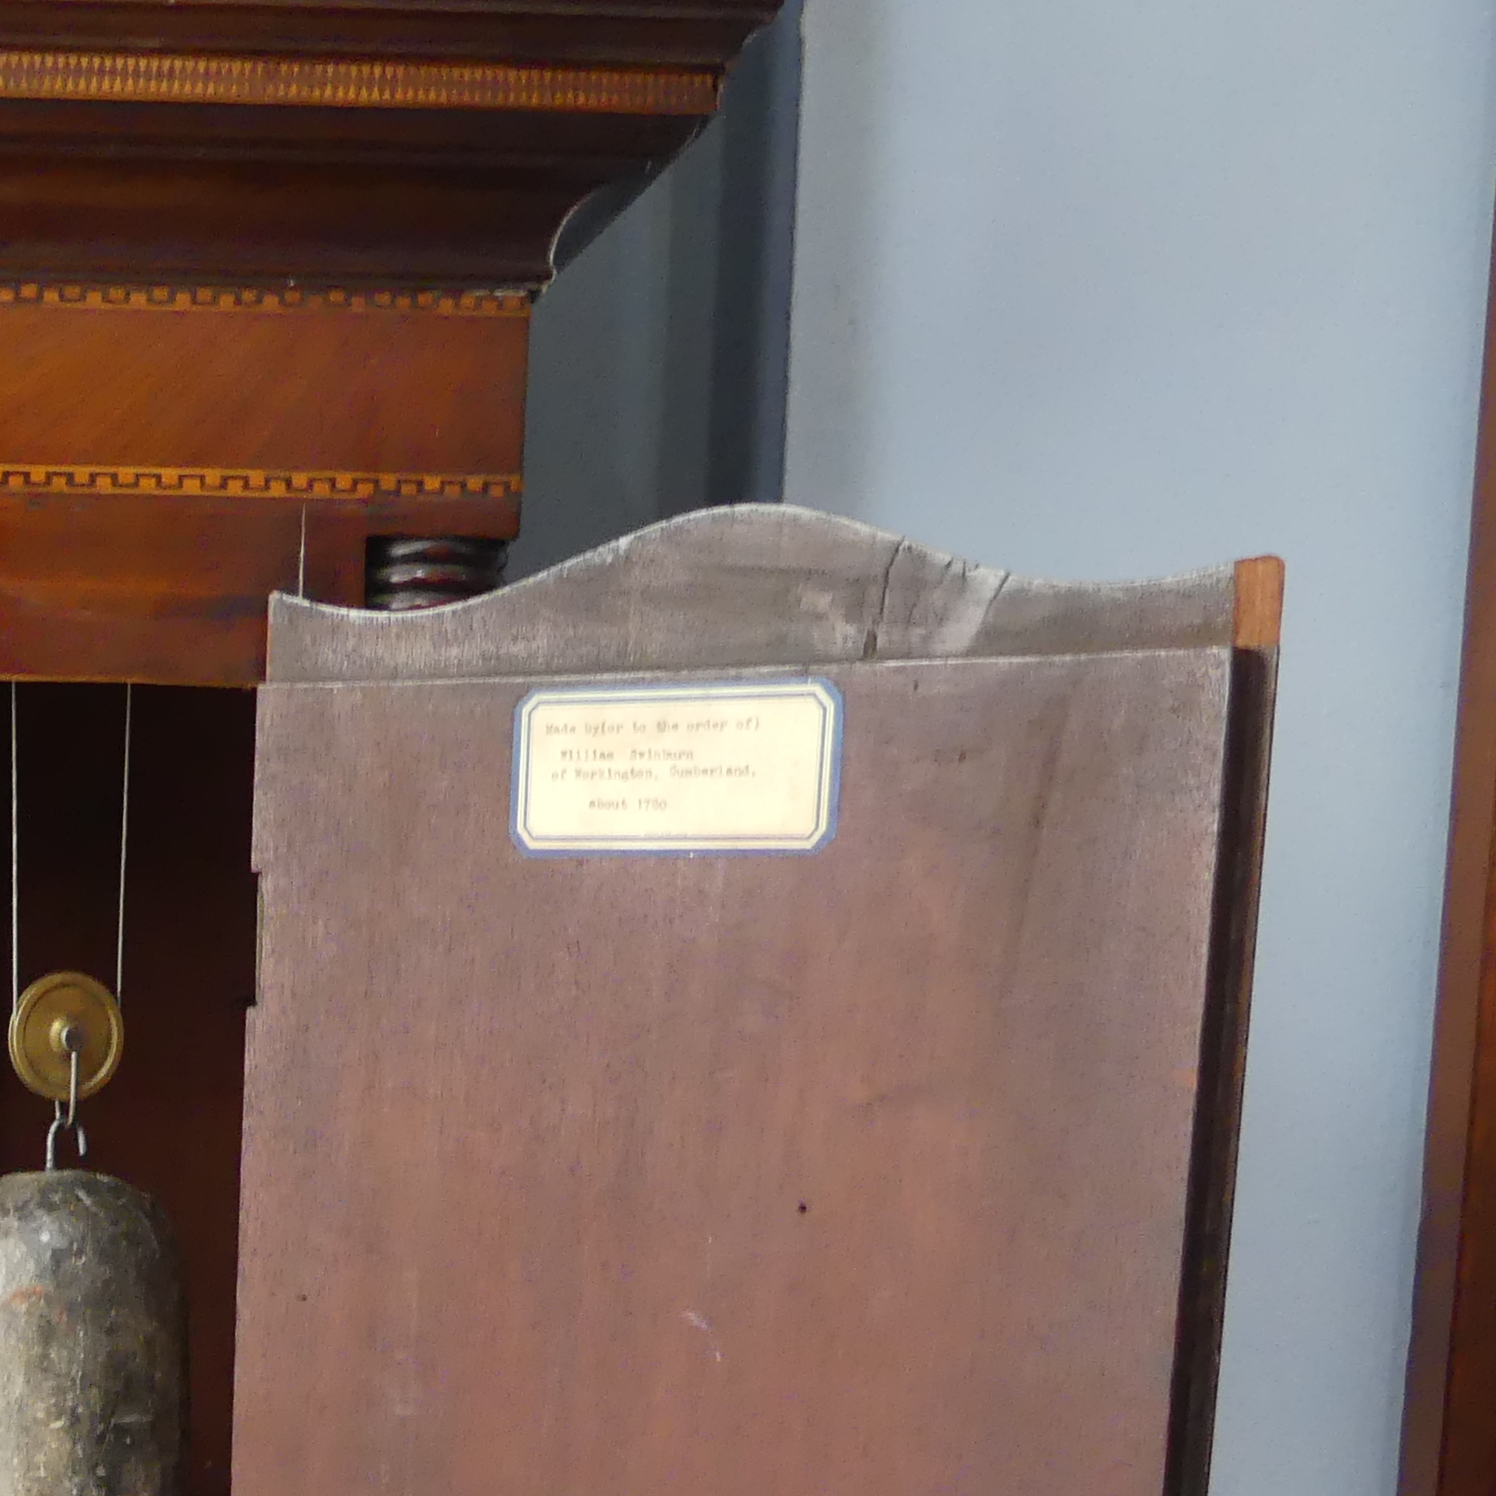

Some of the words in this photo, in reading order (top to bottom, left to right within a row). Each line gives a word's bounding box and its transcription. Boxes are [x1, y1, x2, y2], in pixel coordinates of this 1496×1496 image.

[632, 721, 646, 733] to
[686, 718, 728, 732] order
[560, 748, 615, 761] William
[551, 767, 566, 781] of
[588, 797, 628, 811] About
